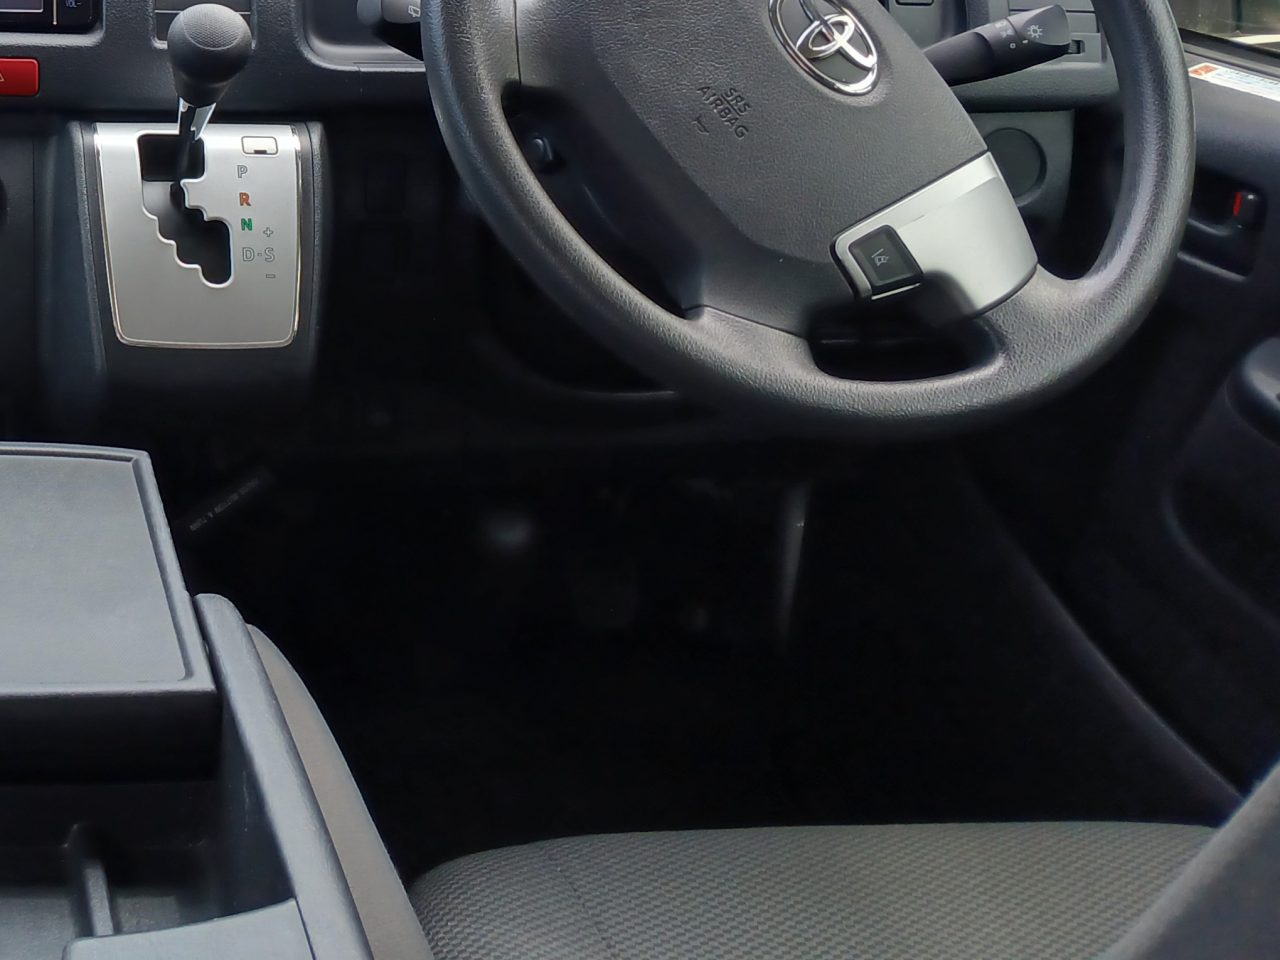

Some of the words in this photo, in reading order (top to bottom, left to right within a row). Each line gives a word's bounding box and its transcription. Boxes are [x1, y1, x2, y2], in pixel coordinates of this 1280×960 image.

[724, 87, 750, 114] SRS
[697, 86, 750, 140] AIRBAG
[237, 164, 248, 178] P
[239, 192, 251, 206] R
[240, 218, 253, 231] N
